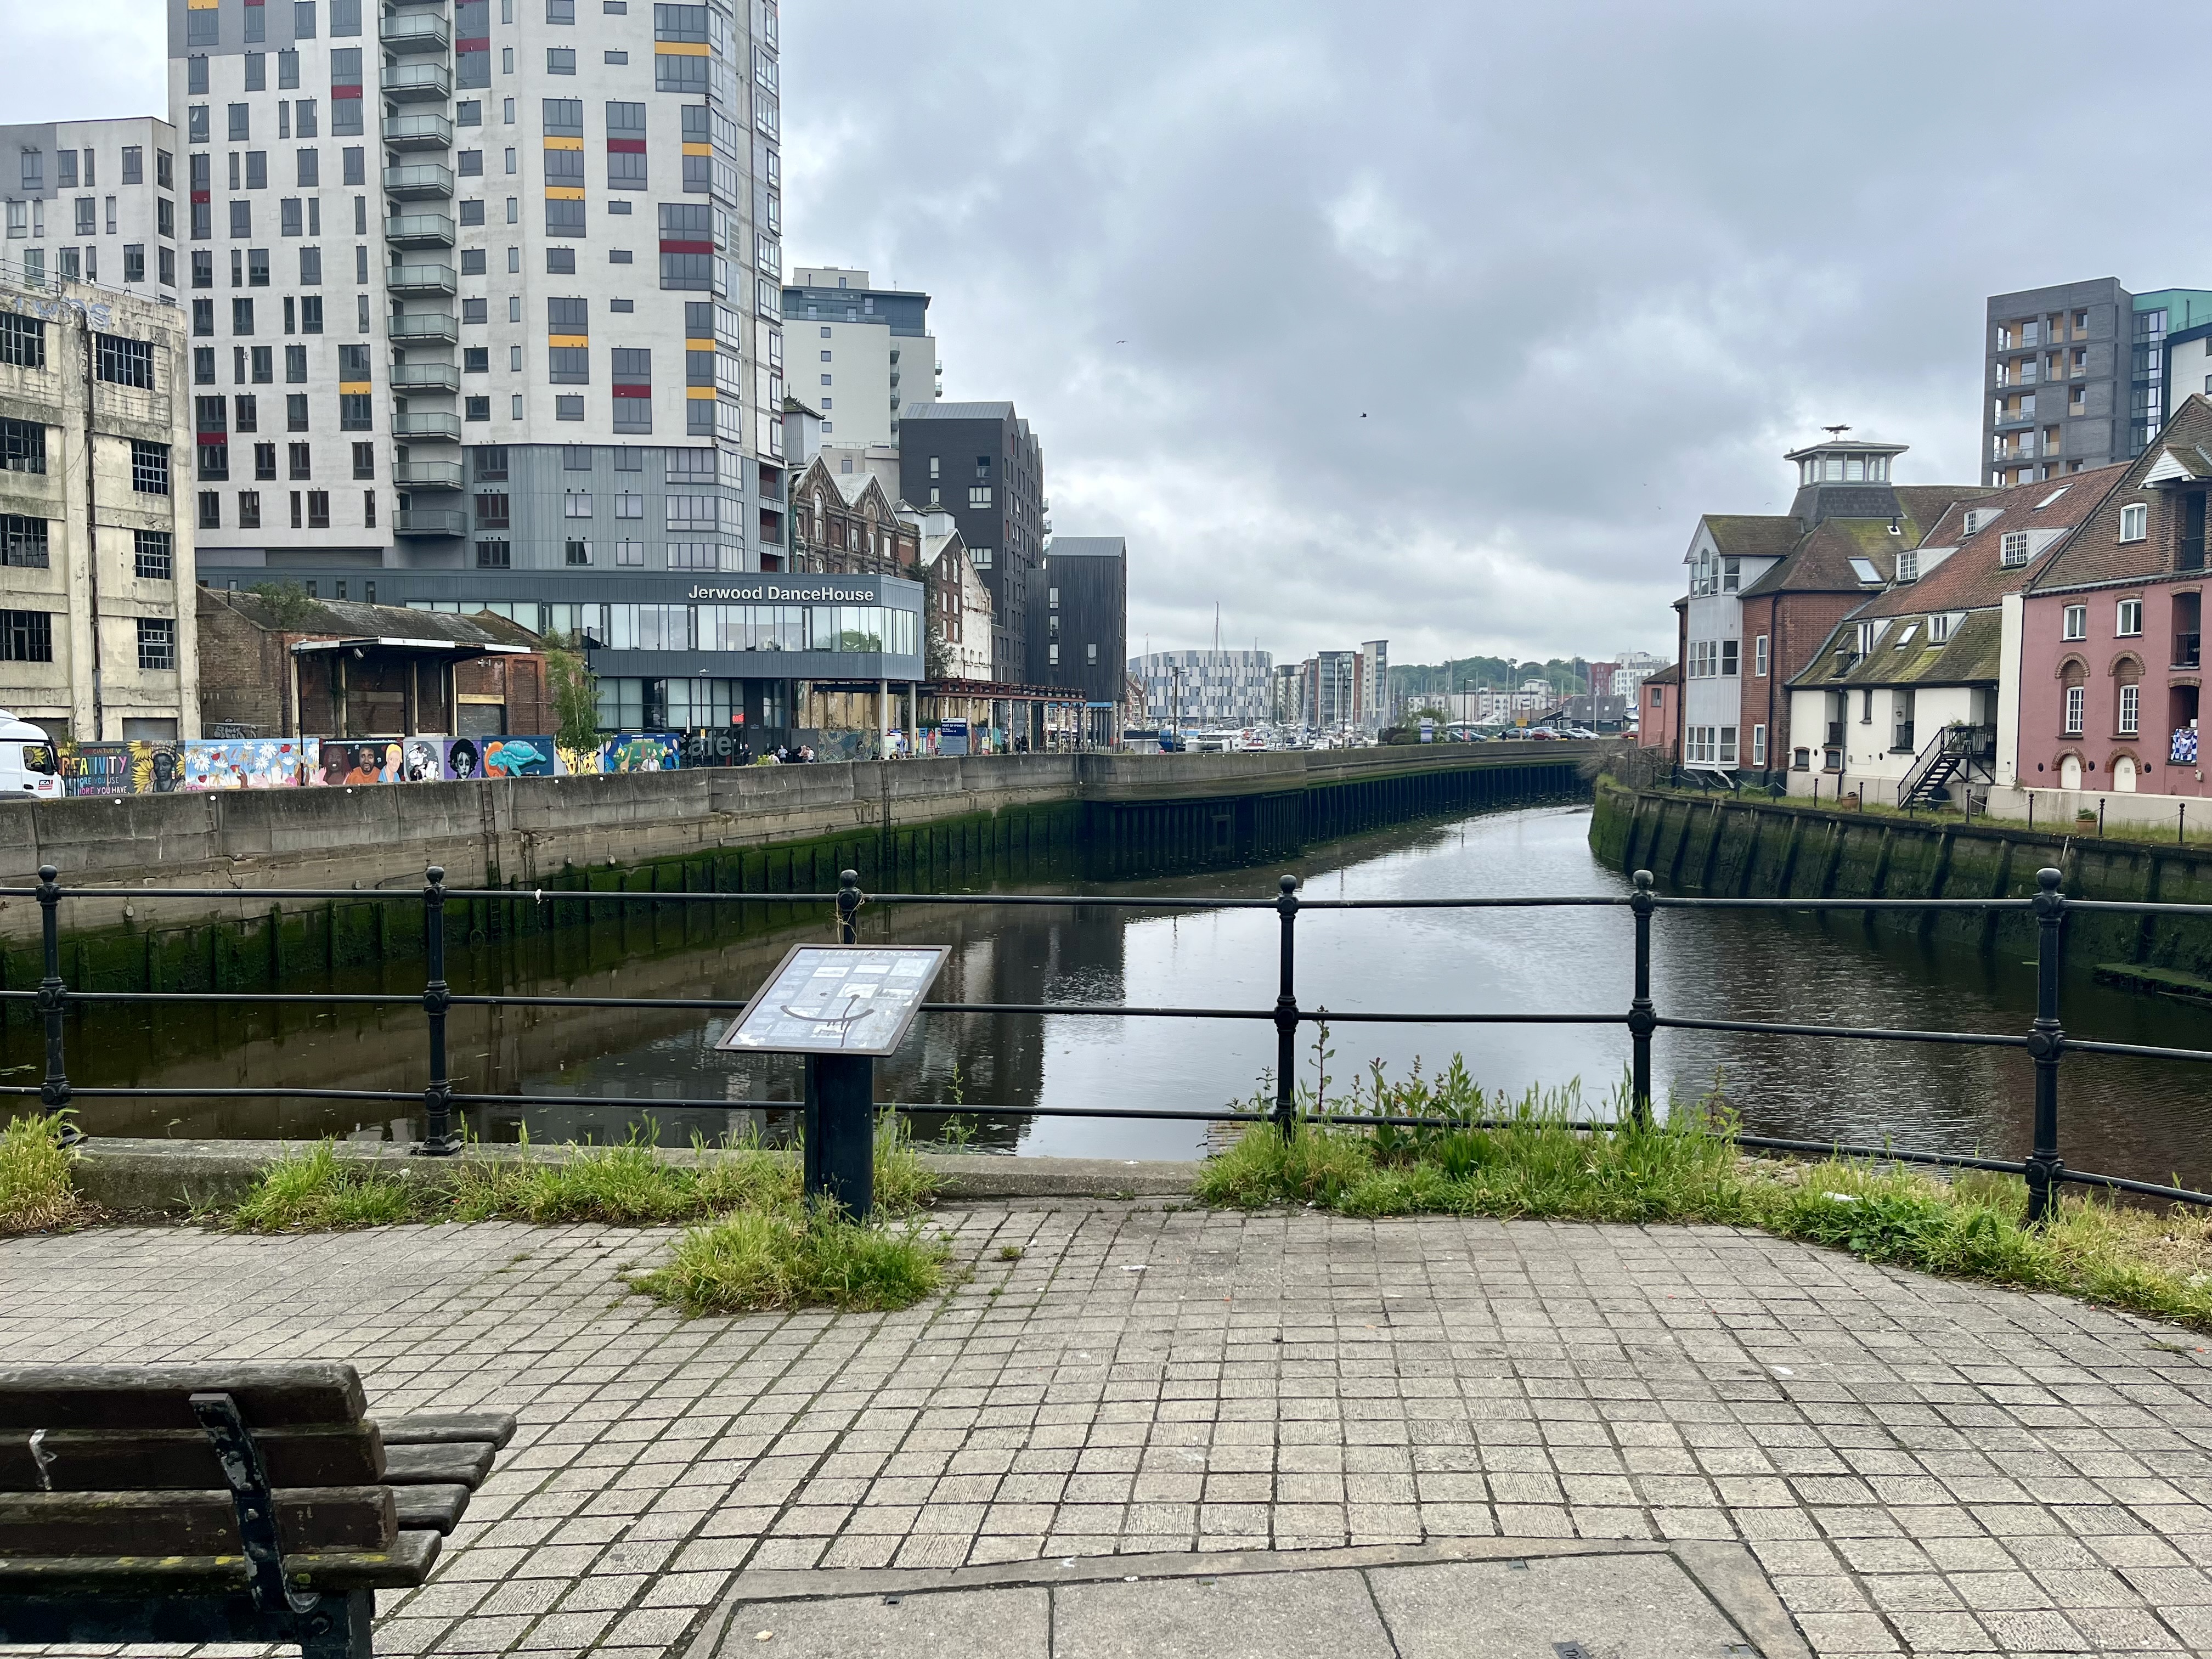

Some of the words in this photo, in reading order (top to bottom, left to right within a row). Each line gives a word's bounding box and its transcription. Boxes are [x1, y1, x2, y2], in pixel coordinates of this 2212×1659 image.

[688, 585, 763, 600] Jerwood
[768, 586, 874, 601] DanceHouse
[78, 777, 92, 785] ORE
[80, 787, 94, 795] ORE
[97, 786, 110, 794] YOU
